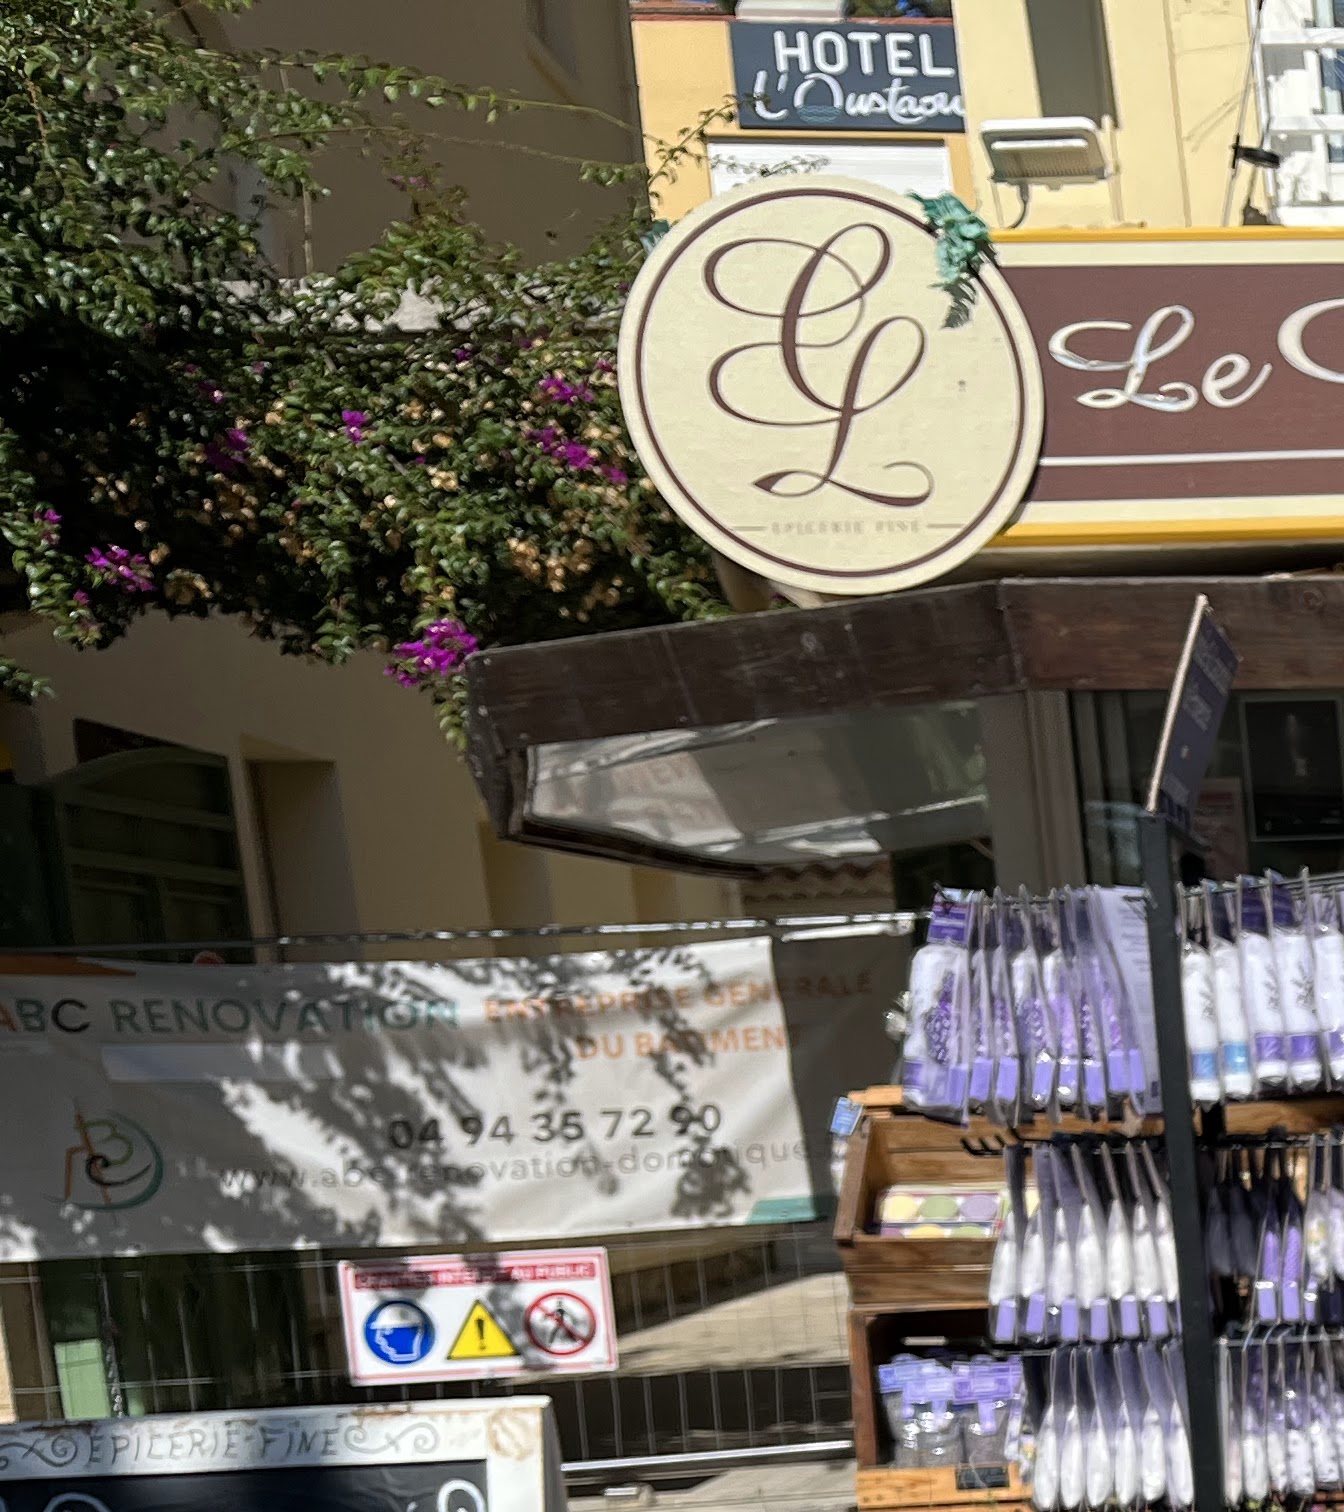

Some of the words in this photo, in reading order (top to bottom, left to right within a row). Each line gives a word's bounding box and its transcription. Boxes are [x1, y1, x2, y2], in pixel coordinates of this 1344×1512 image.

[773, 30, 956, 77] HOTEL
[1048, 304, 1273, 412] Le
[111, 999, 462, 1034] RENOVATION
[573, 1032, 625, 1061] DU
[389, 1118, 442, 1150] 04
[461, 1112, 515, 1147] 94
[530, 1110, 585, 1143] 35
[600, 1108, 655, 1138] 72
[669, 1104, 722, 1136] 90
